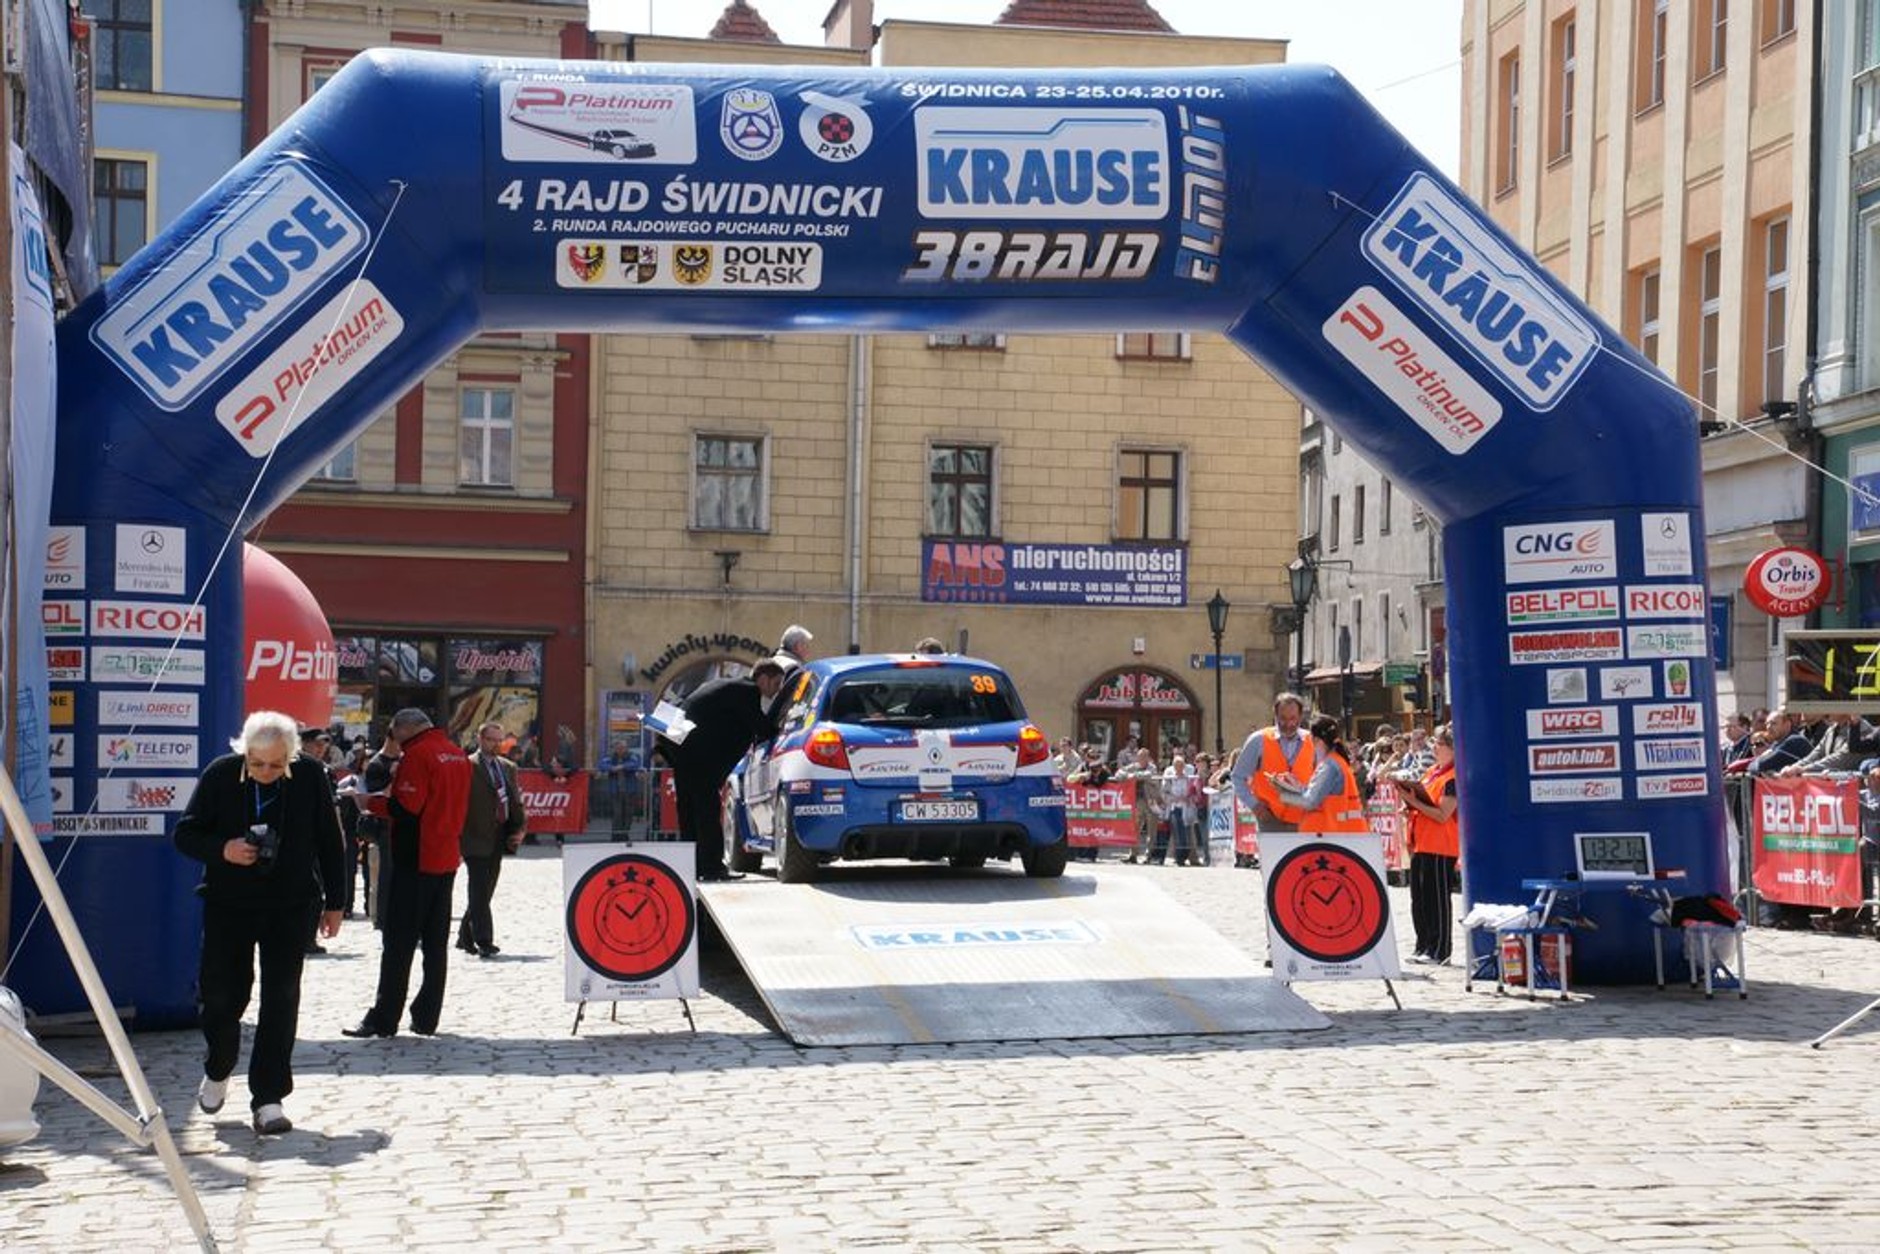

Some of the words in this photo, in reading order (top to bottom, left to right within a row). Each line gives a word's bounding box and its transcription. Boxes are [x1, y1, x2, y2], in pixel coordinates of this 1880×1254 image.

[901, 82, 1026, 98] ŚWIDNICA
[567, 93, 674, 110] Platinum
[817, 143, 857, 159] PZM
[927, 148, 1161, 206] KRAUSE
[497, 180, 523, 211] 4
[536, 180, 650, 212] RAJD
[662, 174, 883, 219] ŚWIDNICKI
[532, 220, 548, 232] 2.
[552, 220, 607, 233] RUNDA
[611, 221, 712, 234] RAJDOWEGO
[715, 222, 790, 236] PUCHARU
[793, 223, 850, 237] POLSKI
[723, 246, 813, 265] DOLNY
[722, 263, 805, 286] ŚLĄSK
[132, 195, 347, 389] KRAUSE
[1381, 206, 1574, 392] KRAUSE
[273, 298, 383, 402] Platinum
[337, 330, 372, 366] ORLEN
[1378, 337, 1485, 434] Platinum
[1416, 393, 1450, 425] ORLEN
[1515, 532, 1573, 554] CNG
[928, 543, 1006, 587] ANS
[1012, 546, 1182, 572] nieruchomości
[1569, 564, 1605, 575] AUTO
[1767, 565, 1816, 583] Orbis
[44, 574, 71, 584] UTO
[1778, 584, 1807, 594] Travel
[1509, 590, 1616, 614] BEL-POL
[1630, 591, 1704, 611] RICOH
[97, 608, 202, 632] RICOH
[246, 640, 336, 681] Platin
[457, 648, 534, 671] Lipstick
[969, 675, 997, 694] 39
[1544, 712, 1600, 728] WRC
[1646, 705, 1696, 726] rally
[136, 743, 192, 755] TELETOP
[904, 805, 927, 818] CW
[930, 803, 976, 817] 53305
[1761, 794, 1857, 835] BEL-POL
[869, 928, 1077, 946] KRAUSE
